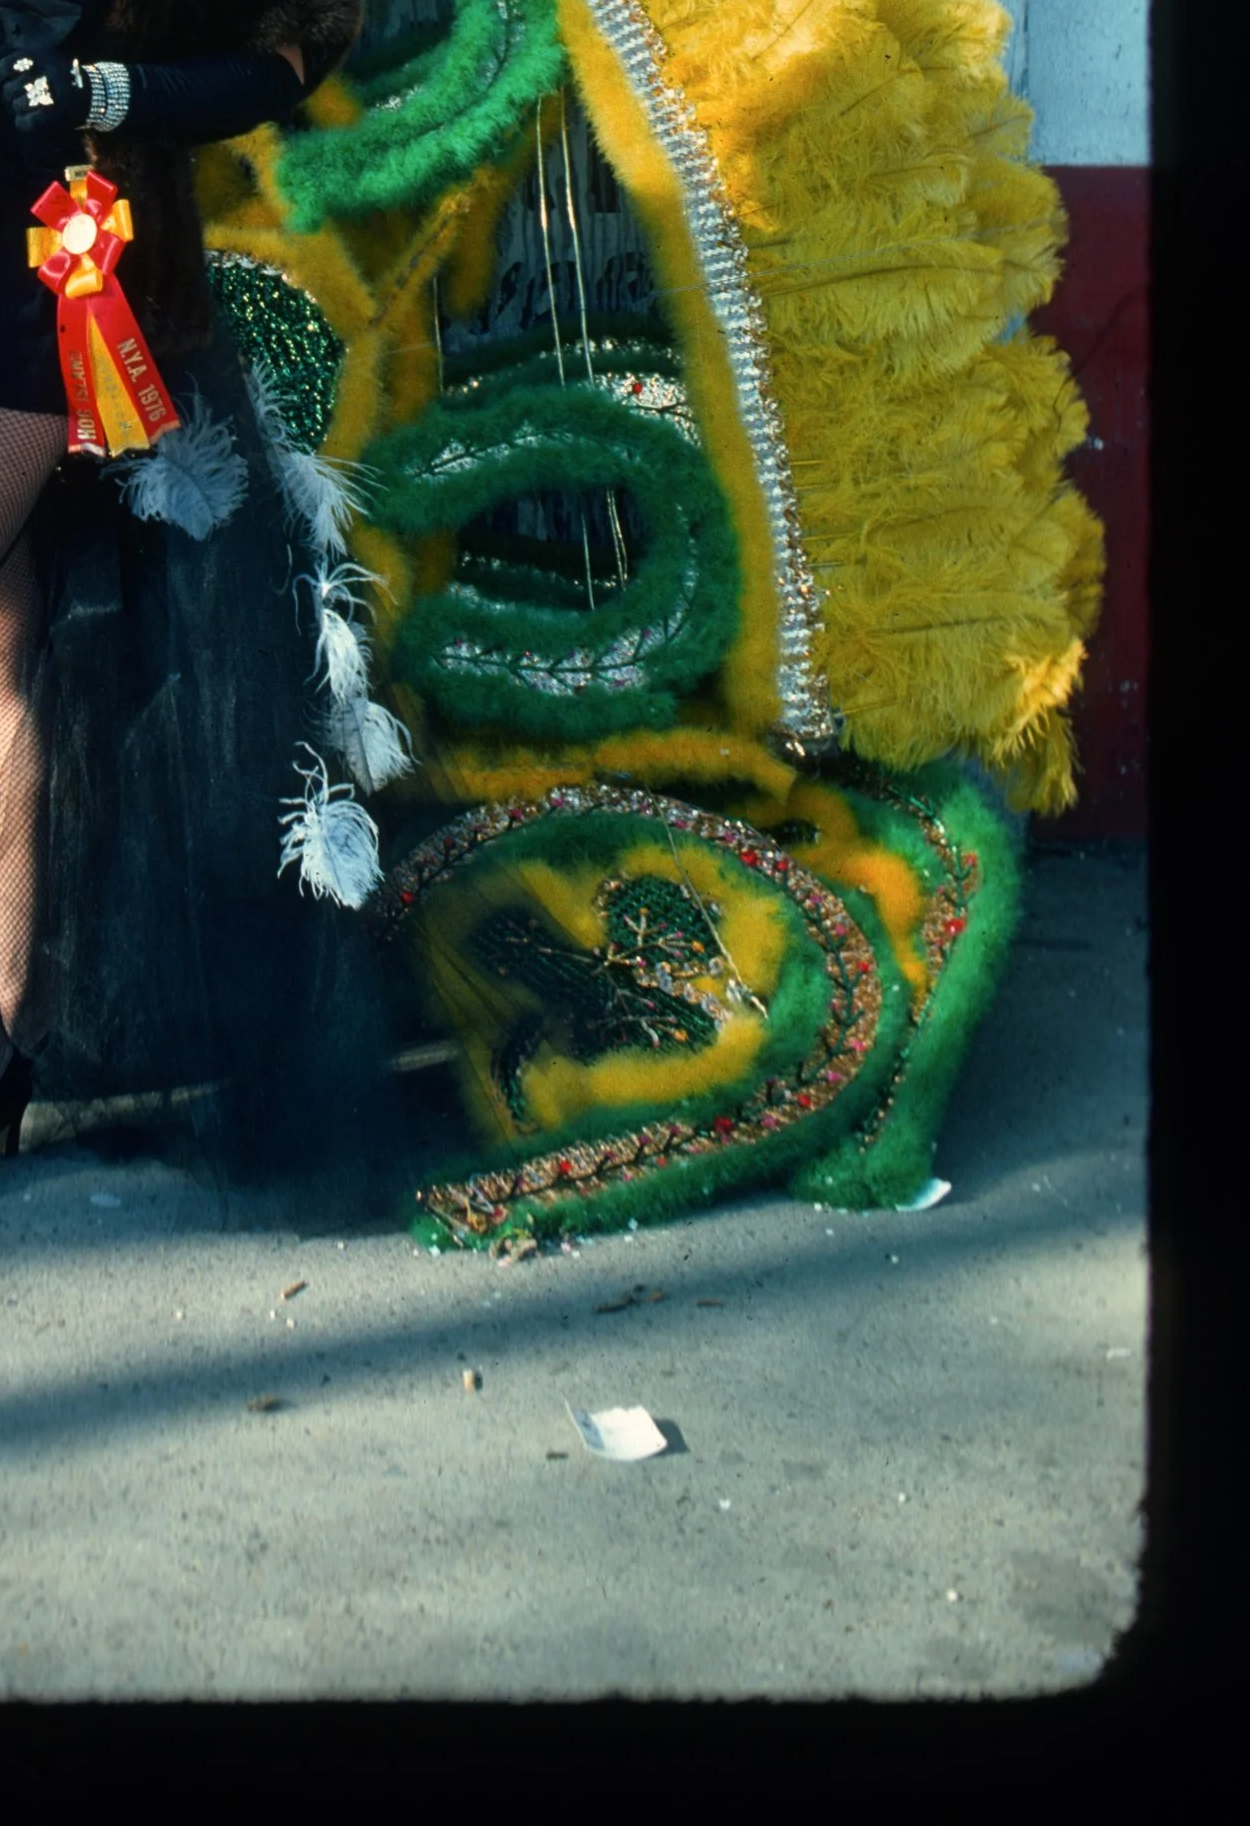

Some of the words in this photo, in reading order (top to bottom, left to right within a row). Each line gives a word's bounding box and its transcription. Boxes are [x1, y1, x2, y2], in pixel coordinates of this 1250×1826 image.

[116, 337, 148, 384] N.Y.A.
[137, 383, 167, 423] 1976
[76, 408, 97, 441] HOG
